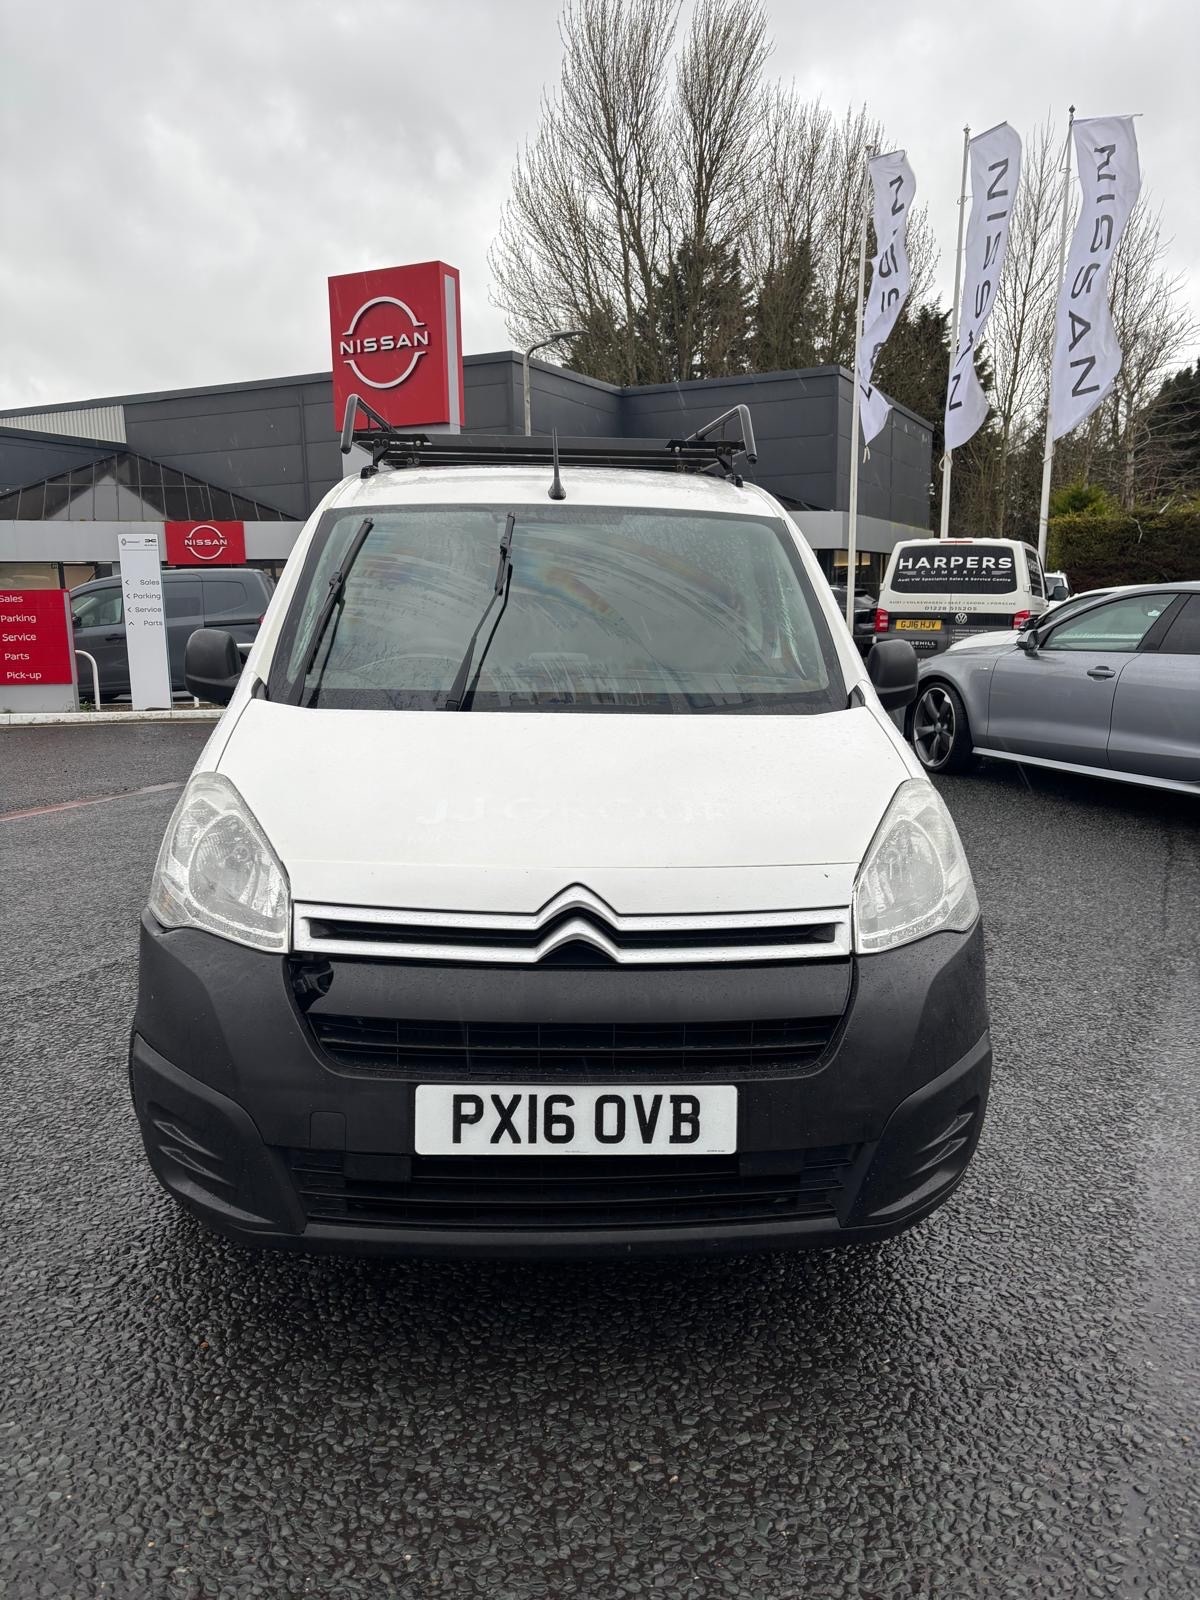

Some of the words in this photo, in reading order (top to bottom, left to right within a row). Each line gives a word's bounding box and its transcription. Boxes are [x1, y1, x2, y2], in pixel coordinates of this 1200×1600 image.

[1069, 144, 1117, 398] NISSAN
[339, 330, 429, 355] NISSAN
[899, 557, 1012, 569] HARPERS
[0, 594, 24, 603] Sales
[133, 592, 161, 600] Parking
[0, 613, 37, 624] Parking
[900, 620, 918, 628] GJ16
[2, 632, 37, 642] Service
[6, 671, 42, 680] Pick-up
[452, 1094, 576, 1144] PX16
[594, 1094, 701, 1144] OVB
